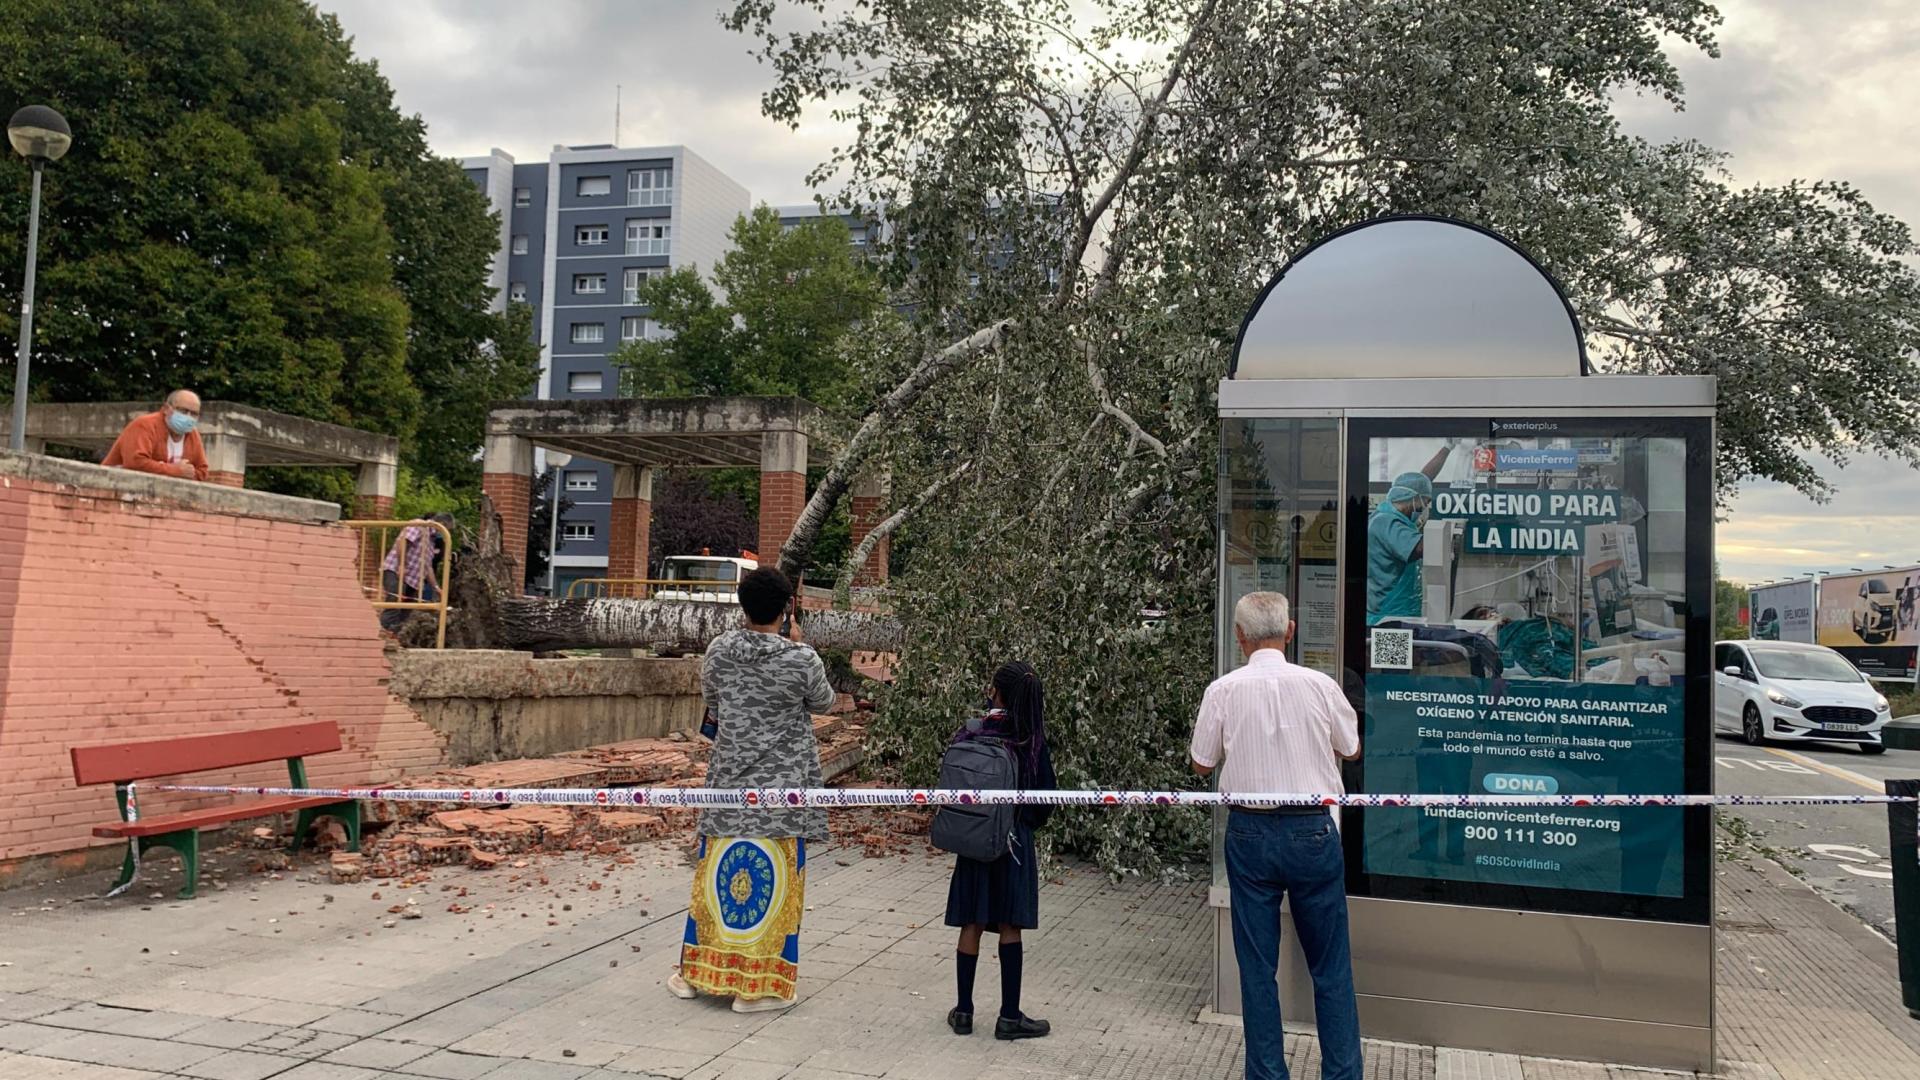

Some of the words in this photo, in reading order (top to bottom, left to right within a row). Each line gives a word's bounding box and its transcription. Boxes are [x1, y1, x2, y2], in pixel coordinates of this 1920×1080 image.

[1502, 421, 1558, 432] exteriorplus
[1436, 487, 1542, 516] OXÍGENO
[1550, 494, 1617, 518] PARA
[1472, 527, 1502, 549] LA
[1510, 528, 1579, 551] INDIA
[1386, 690, 1475, 705] NECESITAMOS
[1477, 695, 1495, 706] TU
[1497, 696, 1542, 709] APOYO
[1544, 698, 1579, 710] PARA
[1581, 701, 1668, 714] GARANTIZAR
[1416, 705, 1475, 720] OXÍGENO
[1478, 710, 1488, 720] Y
[1489, 710, 1556, 724] ATENCIÓN
[1560, 714, 1634, 728] SANITARIA.
[1417, 727, 1444, 739] Esta
[1446, 730, 1504, 742] pandemia
[1506, 734, 1522, 743] no
[1524, 733, 1570, 746] termina
[1572, 736, 1606, 748] hasta
[1608, 739, 1633, 750] que
[1443, 742, 1471, 753] todo
[1473, 744, 1484, 754] el
[1486, 745, 1528, 757] mundo
[1530, 747, 1556, 759] esté
[1558, 750, 1567, 759] a
[1569, 749, 1605, 762] salvo.
[1495, 776, 1548, 793] DONA
[518, 794, 535, 803] 092
[659, 794, 678, 804] 092
[816, 794, 837, 805] 092
[1424, 806, 1621, 832] fundacionvicenteferrer.org
[1464, 825, 1498, 840] 900
[1504, 828, 1536, 844] 111
[1542, 831, 1577, 847] 300
[1475, 855, 1561, 871] #SOSCovidIndia
